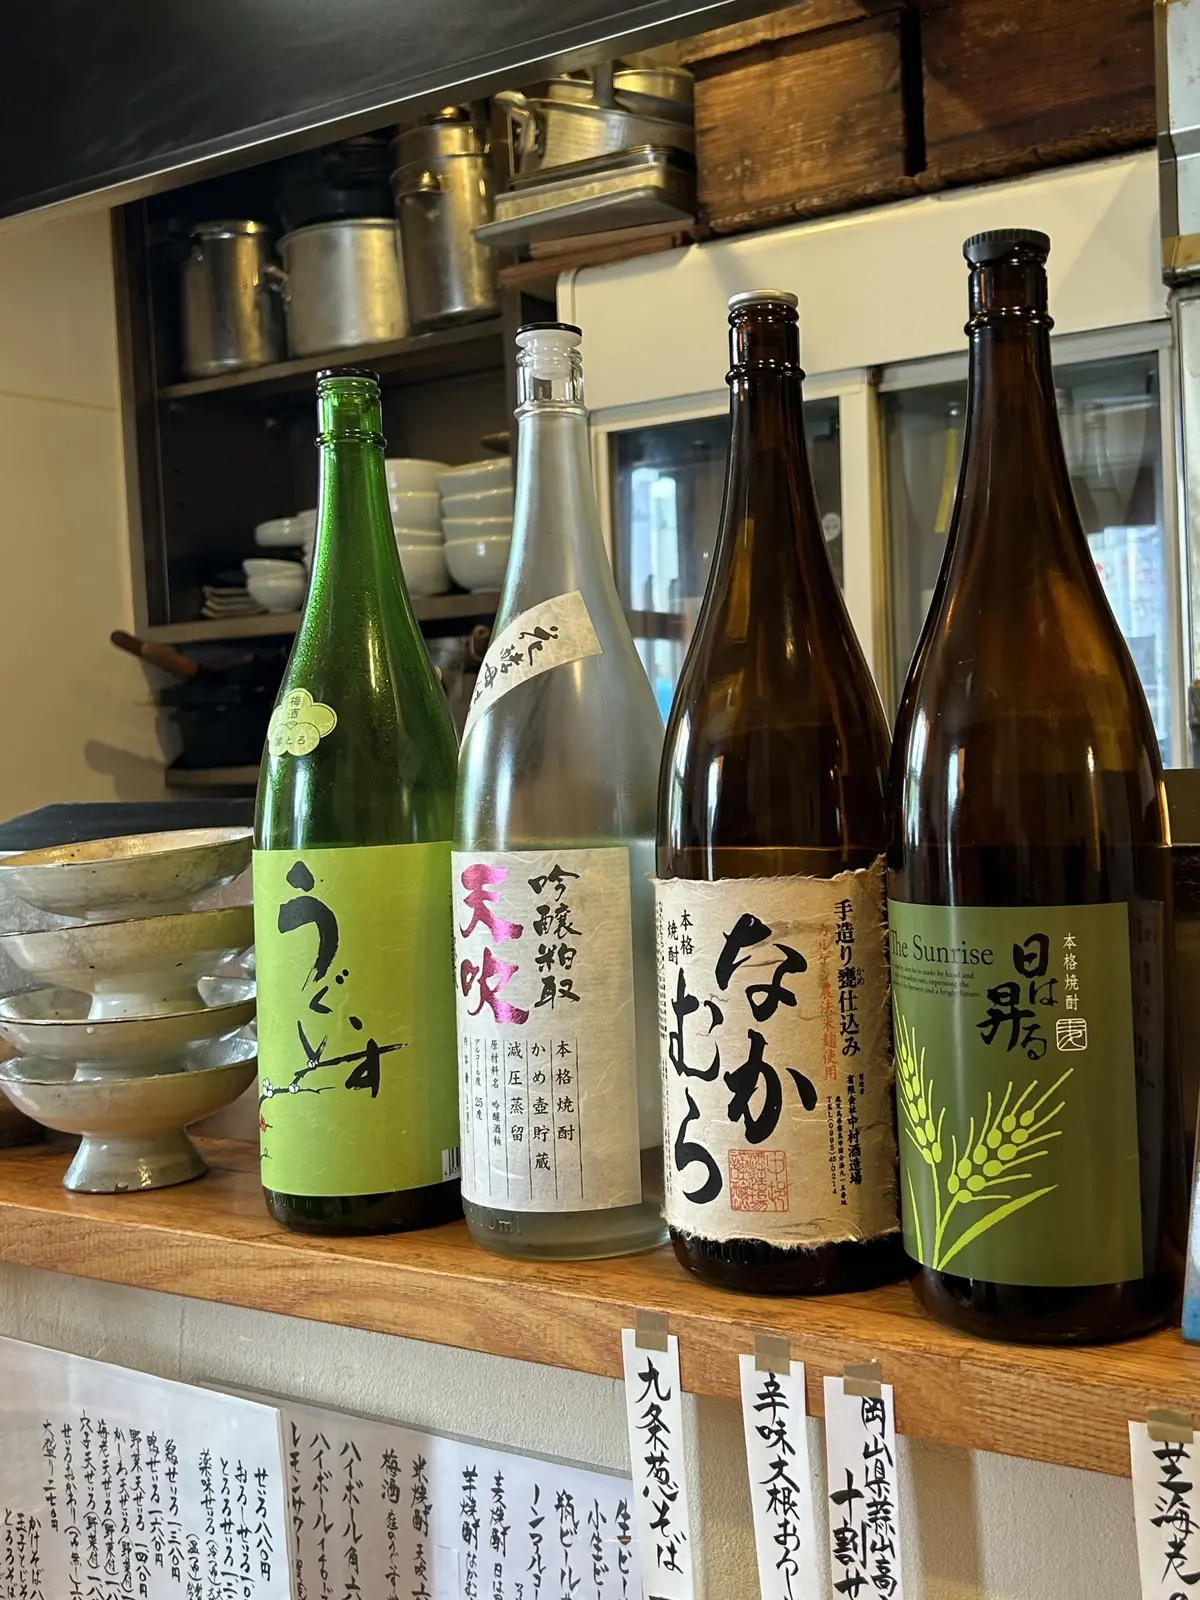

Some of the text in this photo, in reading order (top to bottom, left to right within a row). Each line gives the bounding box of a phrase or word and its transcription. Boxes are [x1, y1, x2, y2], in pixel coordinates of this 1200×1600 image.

[290, 696, 301, 719] 梅酒
[278, 861, 408, 1098] うぐいす
[459, 863, 530, 1025] 天吹
[528, 863, 582, 1010] 吟醸粕取
[667, 920, 679, 965] 焼酎
[680, 909, 695, 956] 本格
[891, 929, 995, 965] The Sunrise
[1062, 933, 1080, 1012] 本格焼酎
[490, 1039, 500, 1089] 原材料名
[715, 912, 818, 1144] なか
[507, 1042, 525, 1142] 減圧蒸留
[555, 1039, 575, 1142] 本格焼酎
[668, 967, 725, 1204] むら
[309, 1433, 334, 1534] ハイボール
[339, 1441, 364, 1544] ハイボール
[380, 1448, 402, 1600] 梅酒 庭のうぐいす
[753, 1372, 801, 1600] 辛味大根おろし
[861, 1397, 898, 1600] 岡山県蒜山高
[463, 1551, 478, 1600] なかむ
[615, 1498, 633, 1600] 生ビー
